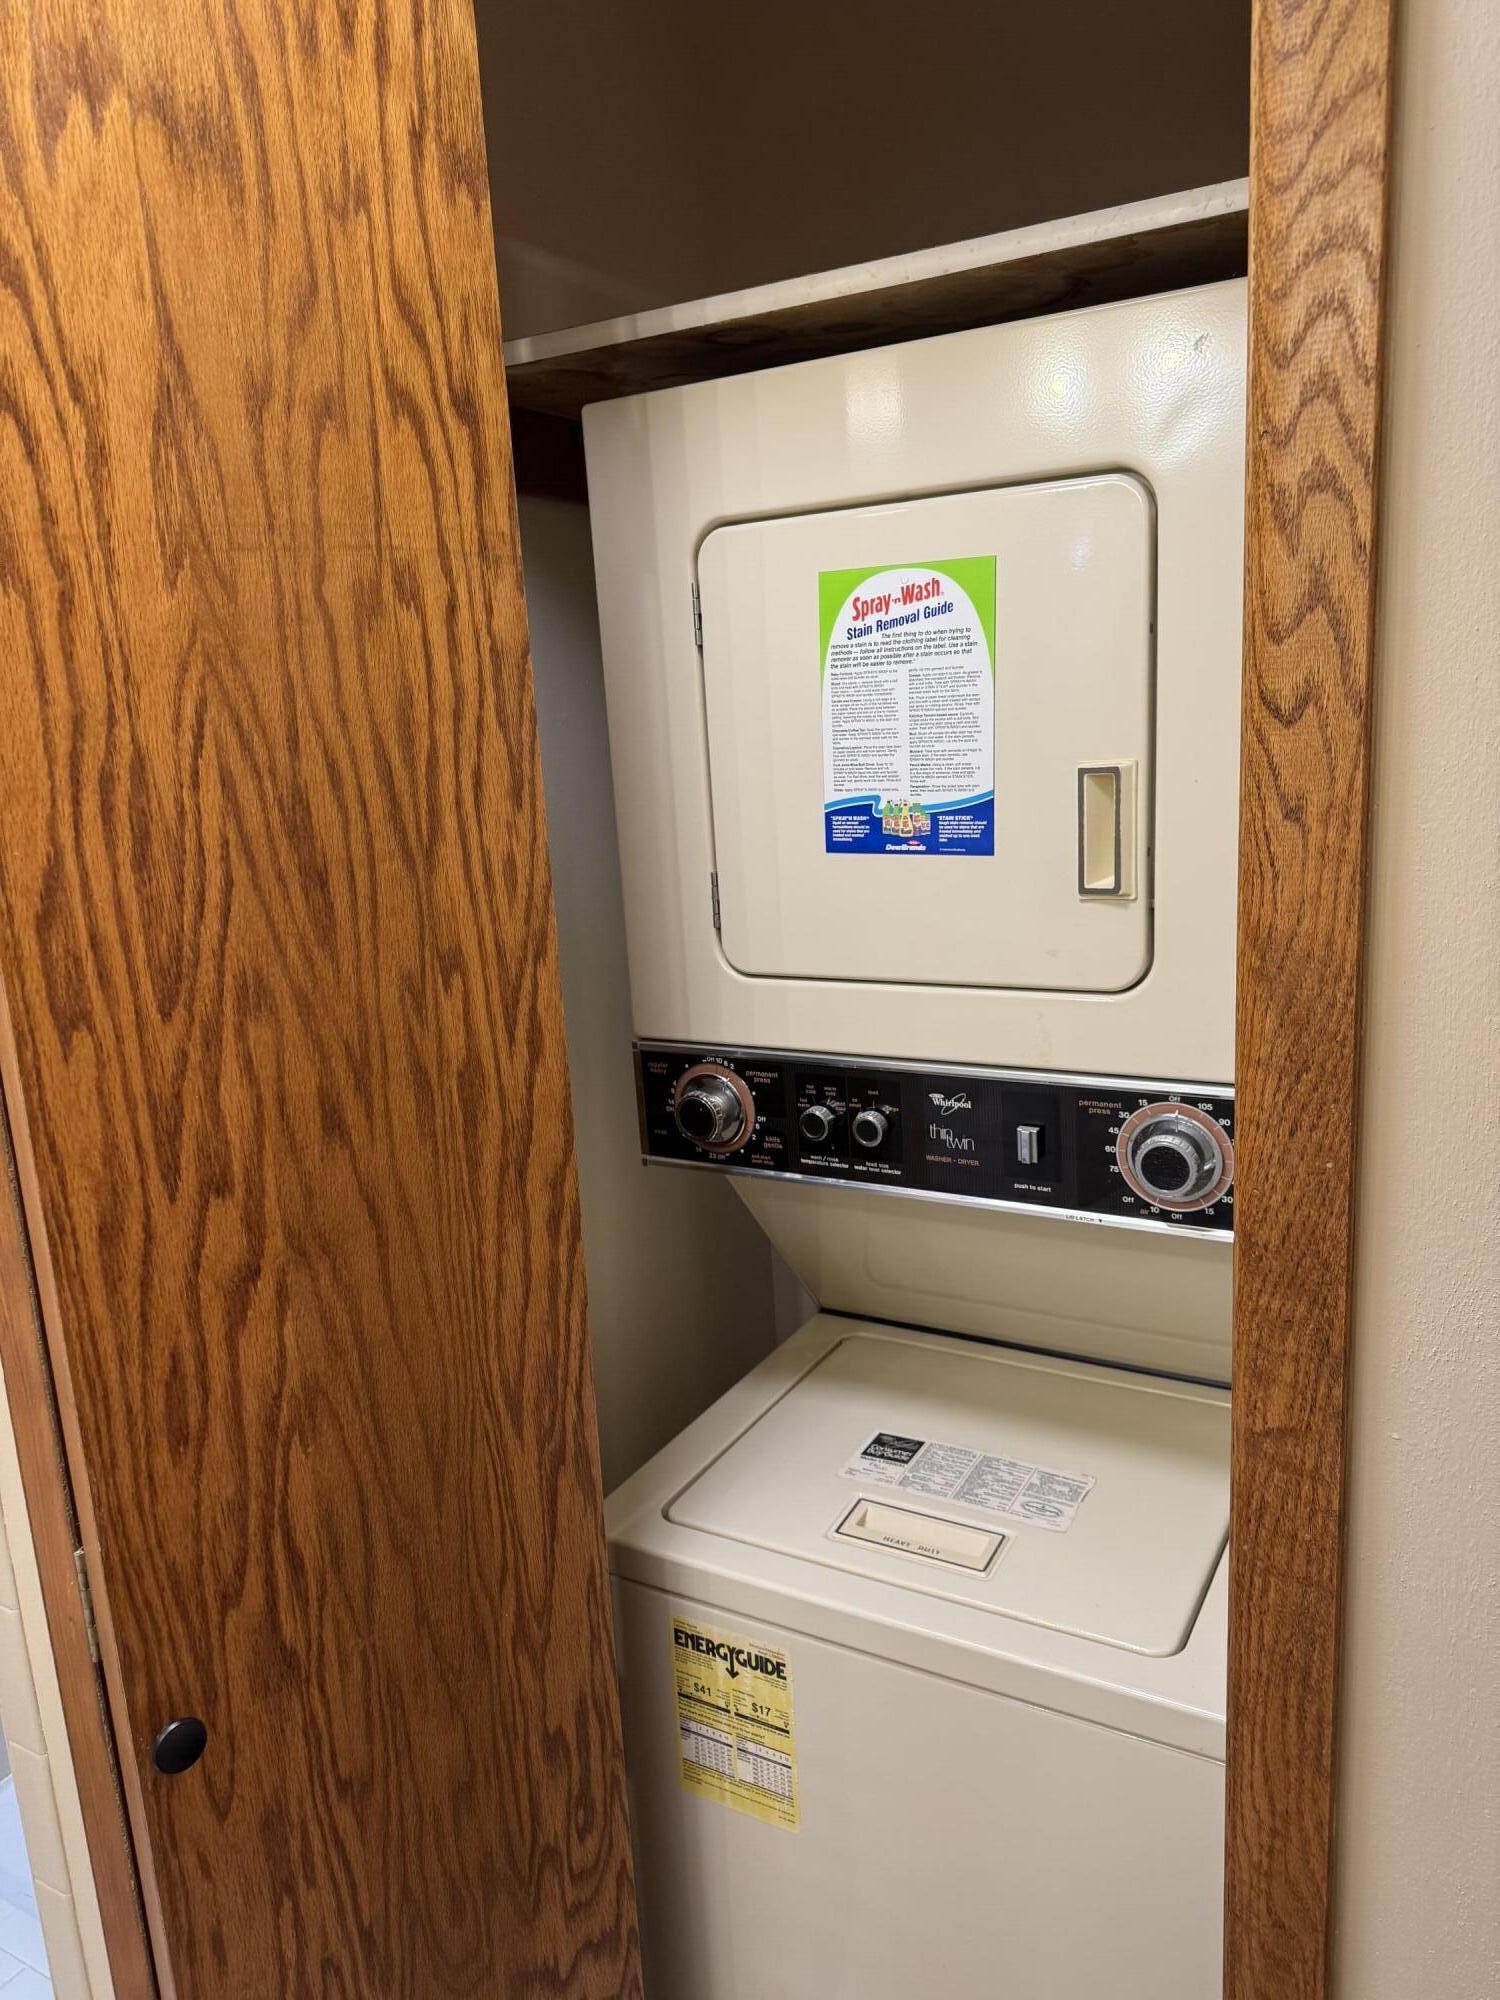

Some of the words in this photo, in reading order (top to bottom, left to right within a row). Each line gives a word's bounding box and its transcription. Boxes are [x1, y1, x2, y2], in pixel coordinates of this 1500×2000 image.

[852, 593, 891, 622] Spray
[900, 578, 940, 606] Wash
[846, 624, 872, 640] Stain
[876, 609, 920, 632] Removal
[924, 601, 954, 619] Guide
[932, 1096, 972, 1110] Whirlpool
[1078, 1100, 1122, 1109] permanent
[946, 1134, 975, 1151] twin
[926, 1154, 952, 1163] WASHER
[882, 1536, 910, 1546] HEAVY
[918, 1545, 940, 1554] DUTY
[674, 1628, 786, 1680] ENERGYGUIDE
[694, 1682, 711, 1696] $41
[752, 1702, 771, 1716] $17
